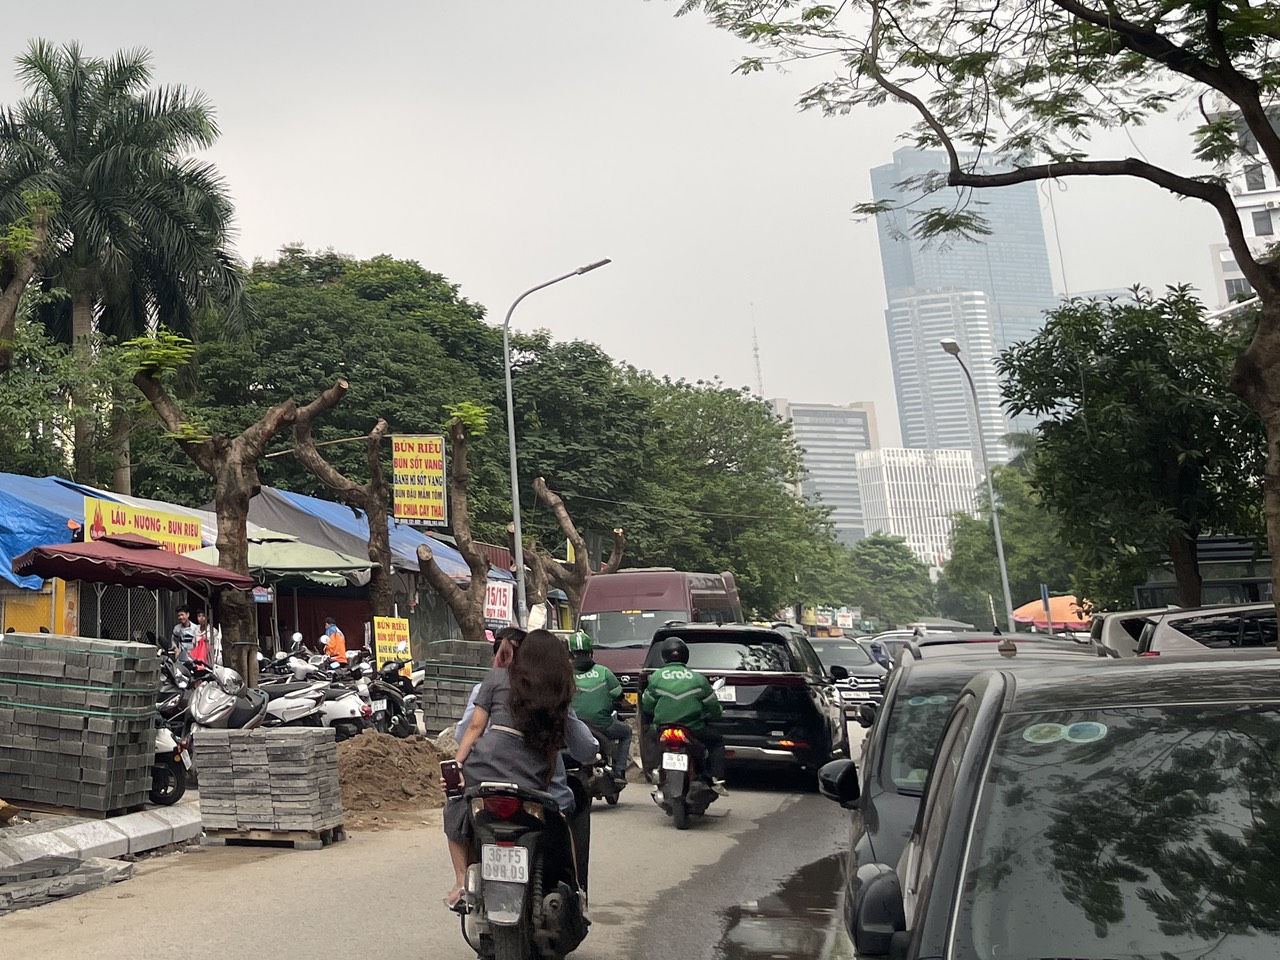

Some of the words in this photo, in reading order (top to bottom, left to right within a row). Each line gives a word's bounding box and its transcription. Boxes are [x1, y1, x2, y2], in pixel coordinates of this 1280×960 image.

[394, 439, 415, 453] BÚN
[417, 440, 442, 454] RIÊU
[424, 459, 443, 470] VANG
[487, 586, 508, 607] 15/15
[661, 669, 694, 680] Grab
[489, 847, 521, 864] 36-F5
